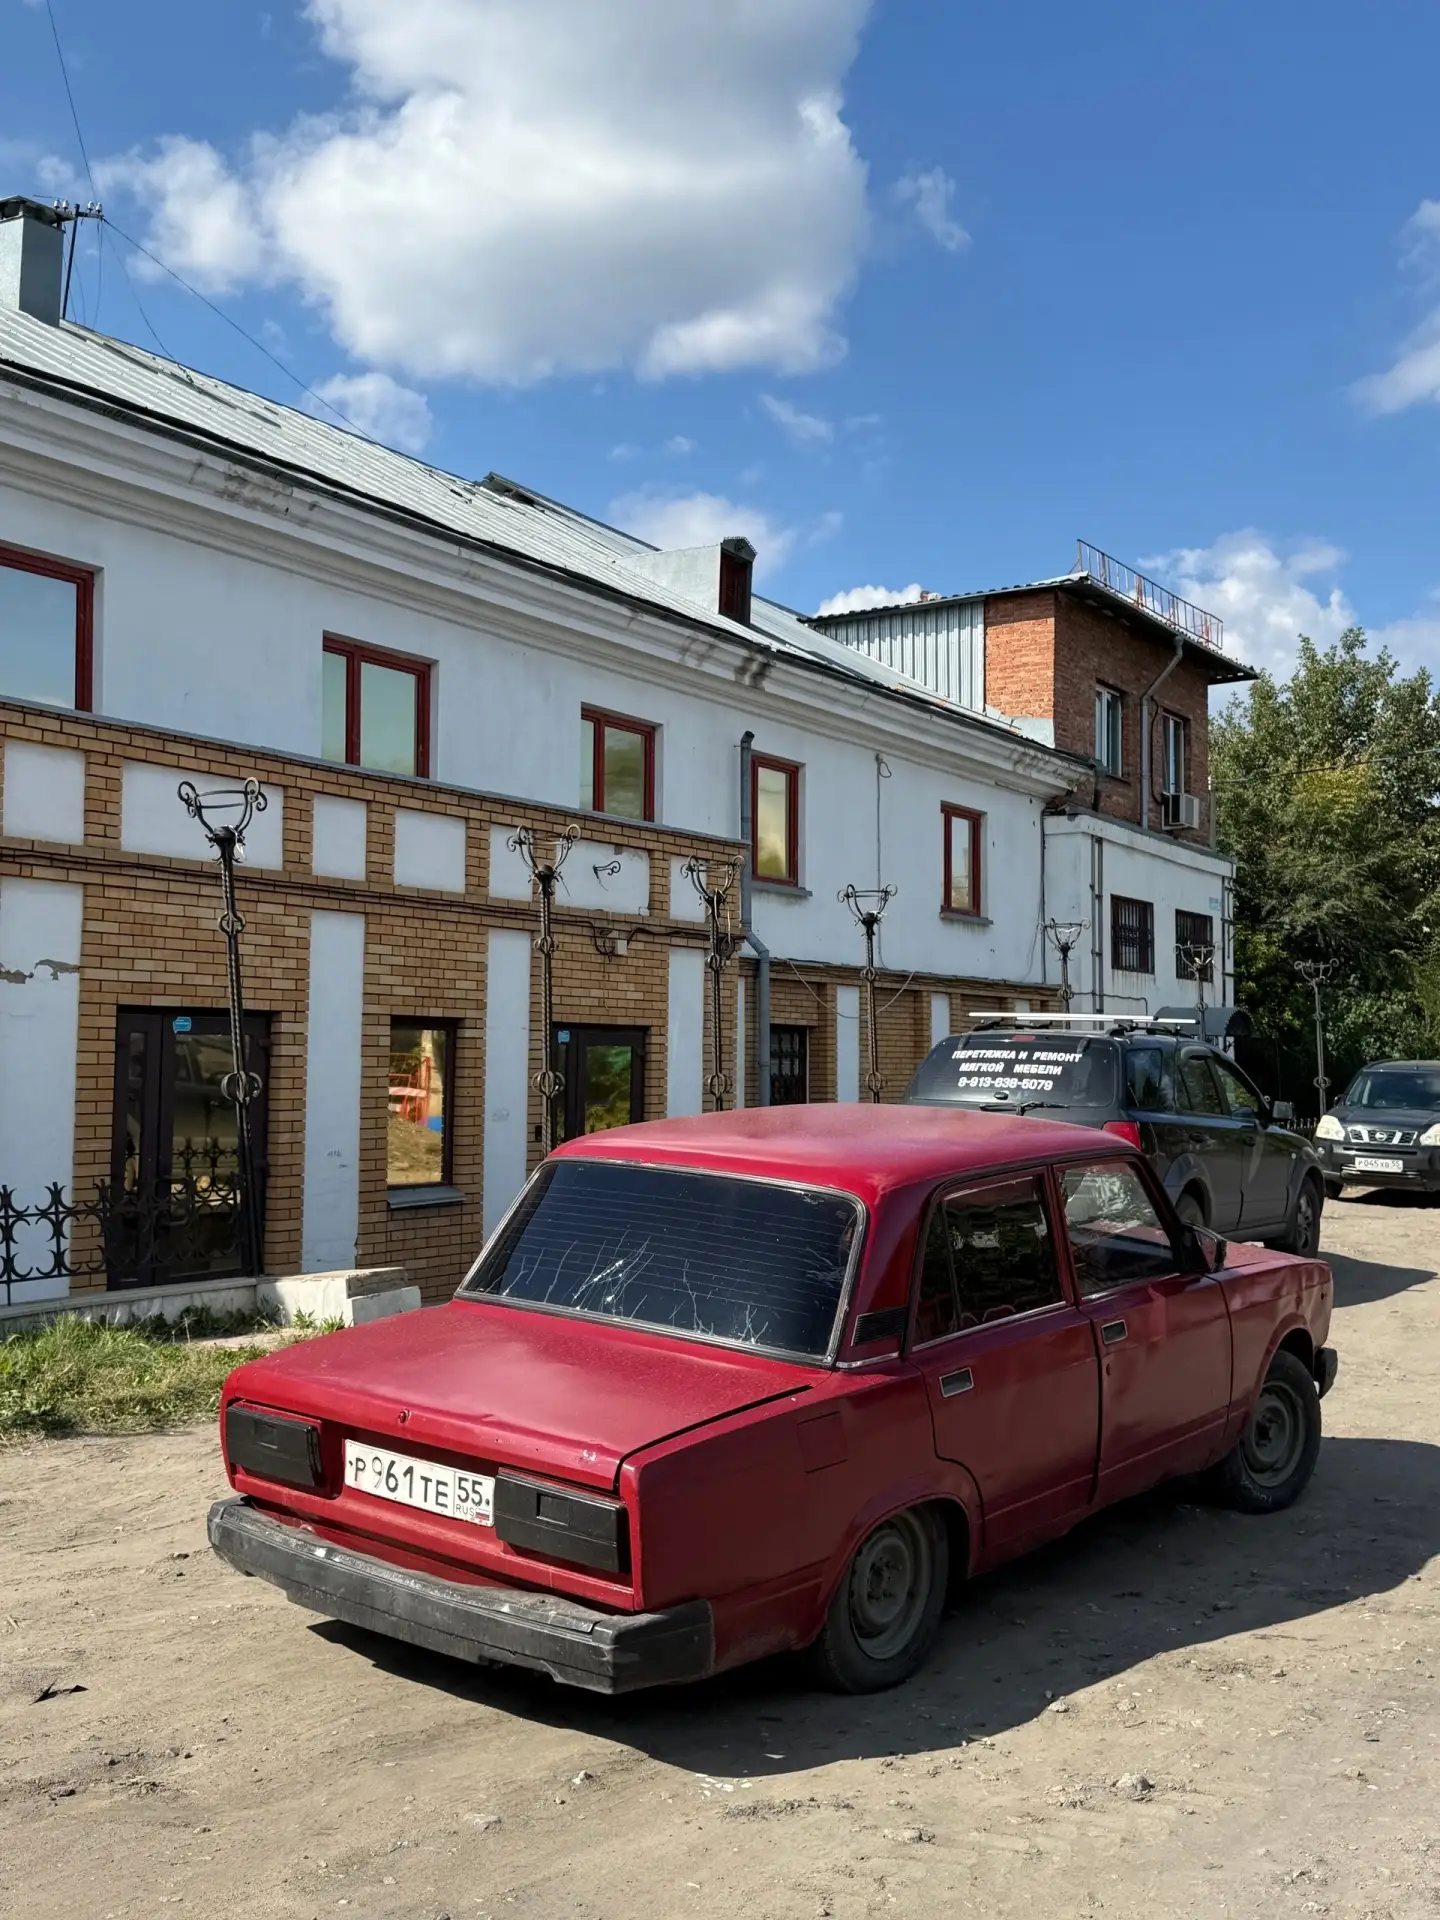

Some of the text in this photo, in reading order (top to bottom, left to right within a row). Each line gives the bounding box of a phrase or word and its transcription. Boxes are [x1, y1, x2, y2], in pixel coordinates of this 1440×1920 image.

[951, 1049, 1083, 1063] ПЕРЕТЯЖКА И РЕМОНТ
[959, 1061, 1062, 1076] МЯГКОЙ МЕБЕЛИ
[457, 1476, 484, 1508] 55
[455, 1503, 475, 1517] RUS
